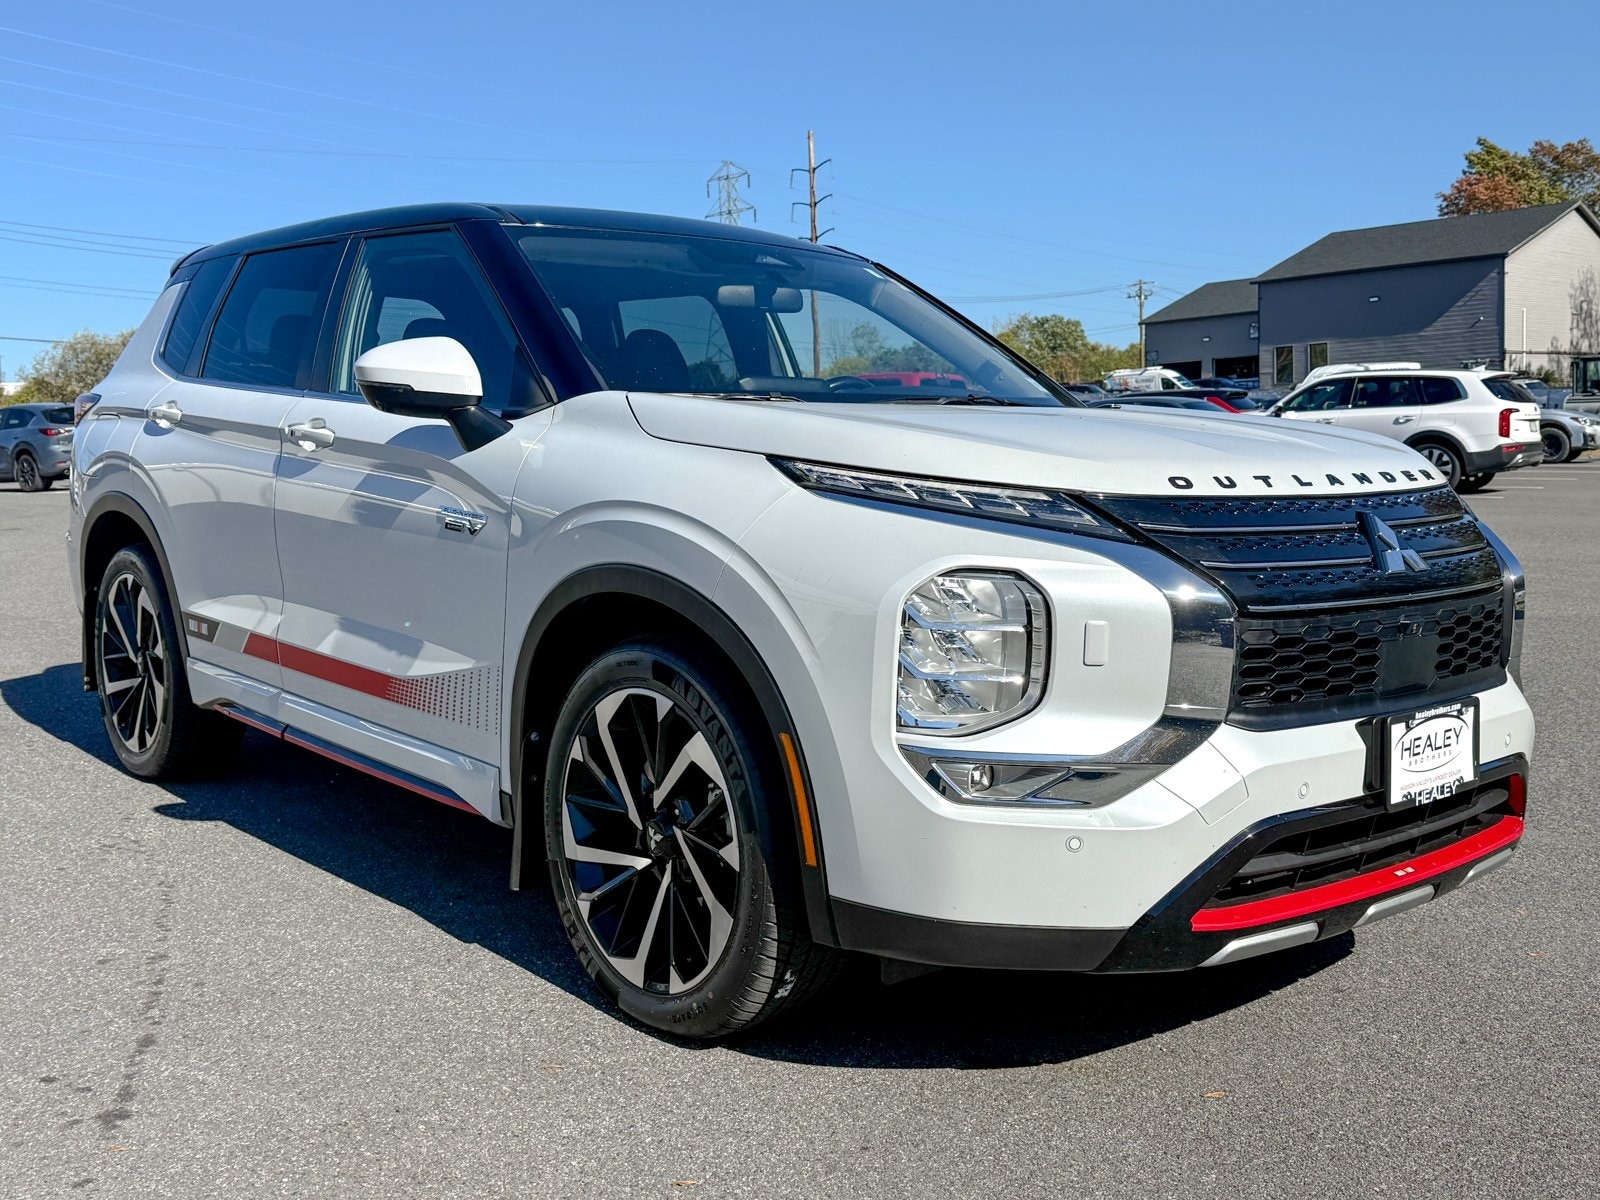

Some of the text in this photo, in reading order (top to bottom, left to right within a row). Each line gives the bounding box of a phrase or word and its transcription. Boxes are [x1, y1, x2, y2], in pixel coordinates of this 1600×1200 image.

[1168, 469, 1435, 489] OUTLANDER
[1415, 703, 1461, 719] healeybrothers.com
[672, 673, 746, 798] ADVANTA
[1401, 725, 1463, 760] HEALEY
[1409, 749, 1452, 767] BROTHERS
[1415, 782, 1458, 806] HEALEY
